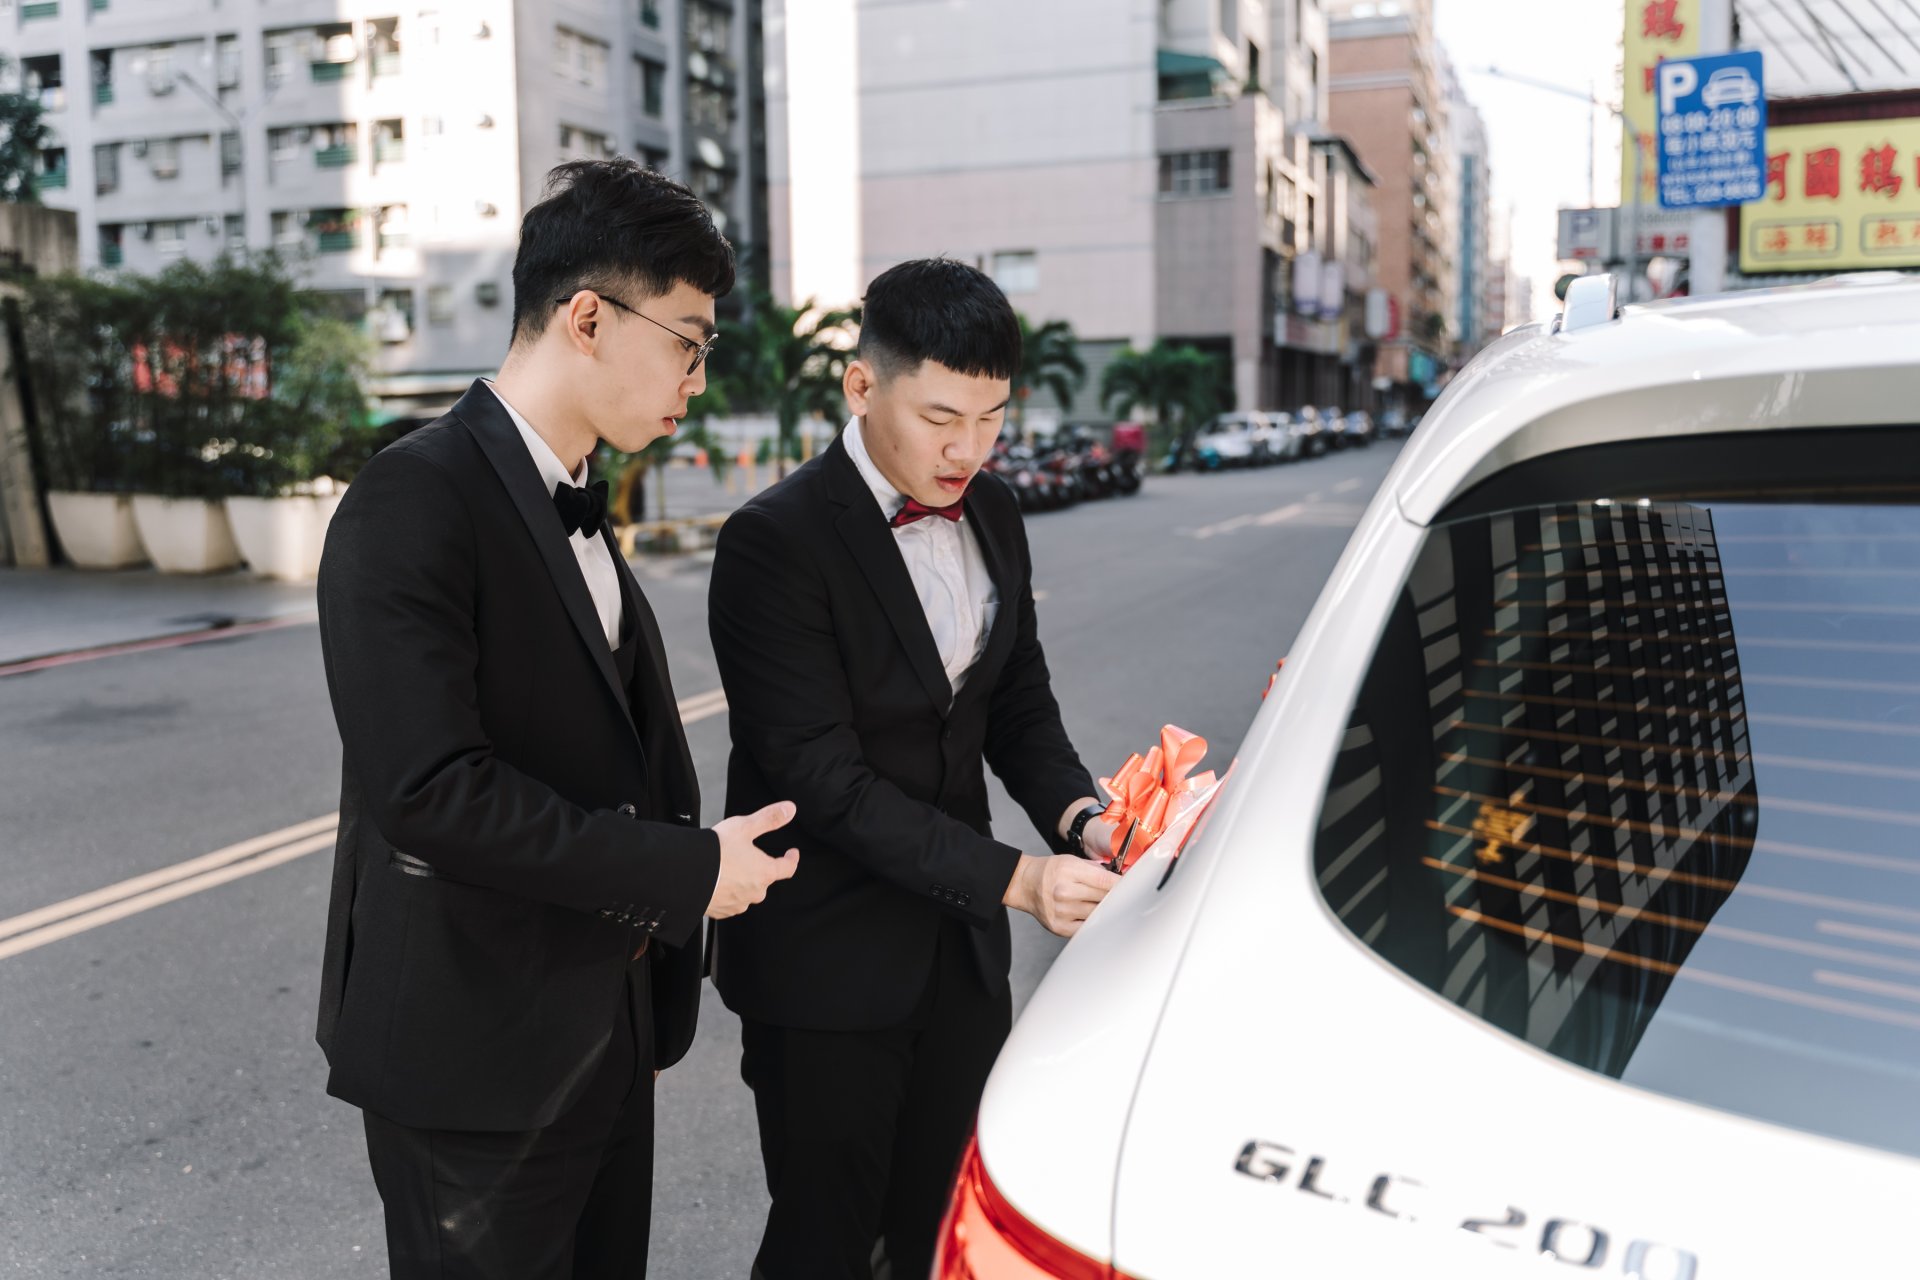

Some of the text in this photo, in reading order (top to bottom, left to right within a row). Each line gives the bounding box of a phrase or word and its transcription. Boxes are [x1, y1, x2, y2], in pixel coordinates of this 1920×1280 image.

[1660, 62, 1698, 115] P
[1232, 1138, 1699, 1280] GLC 200
